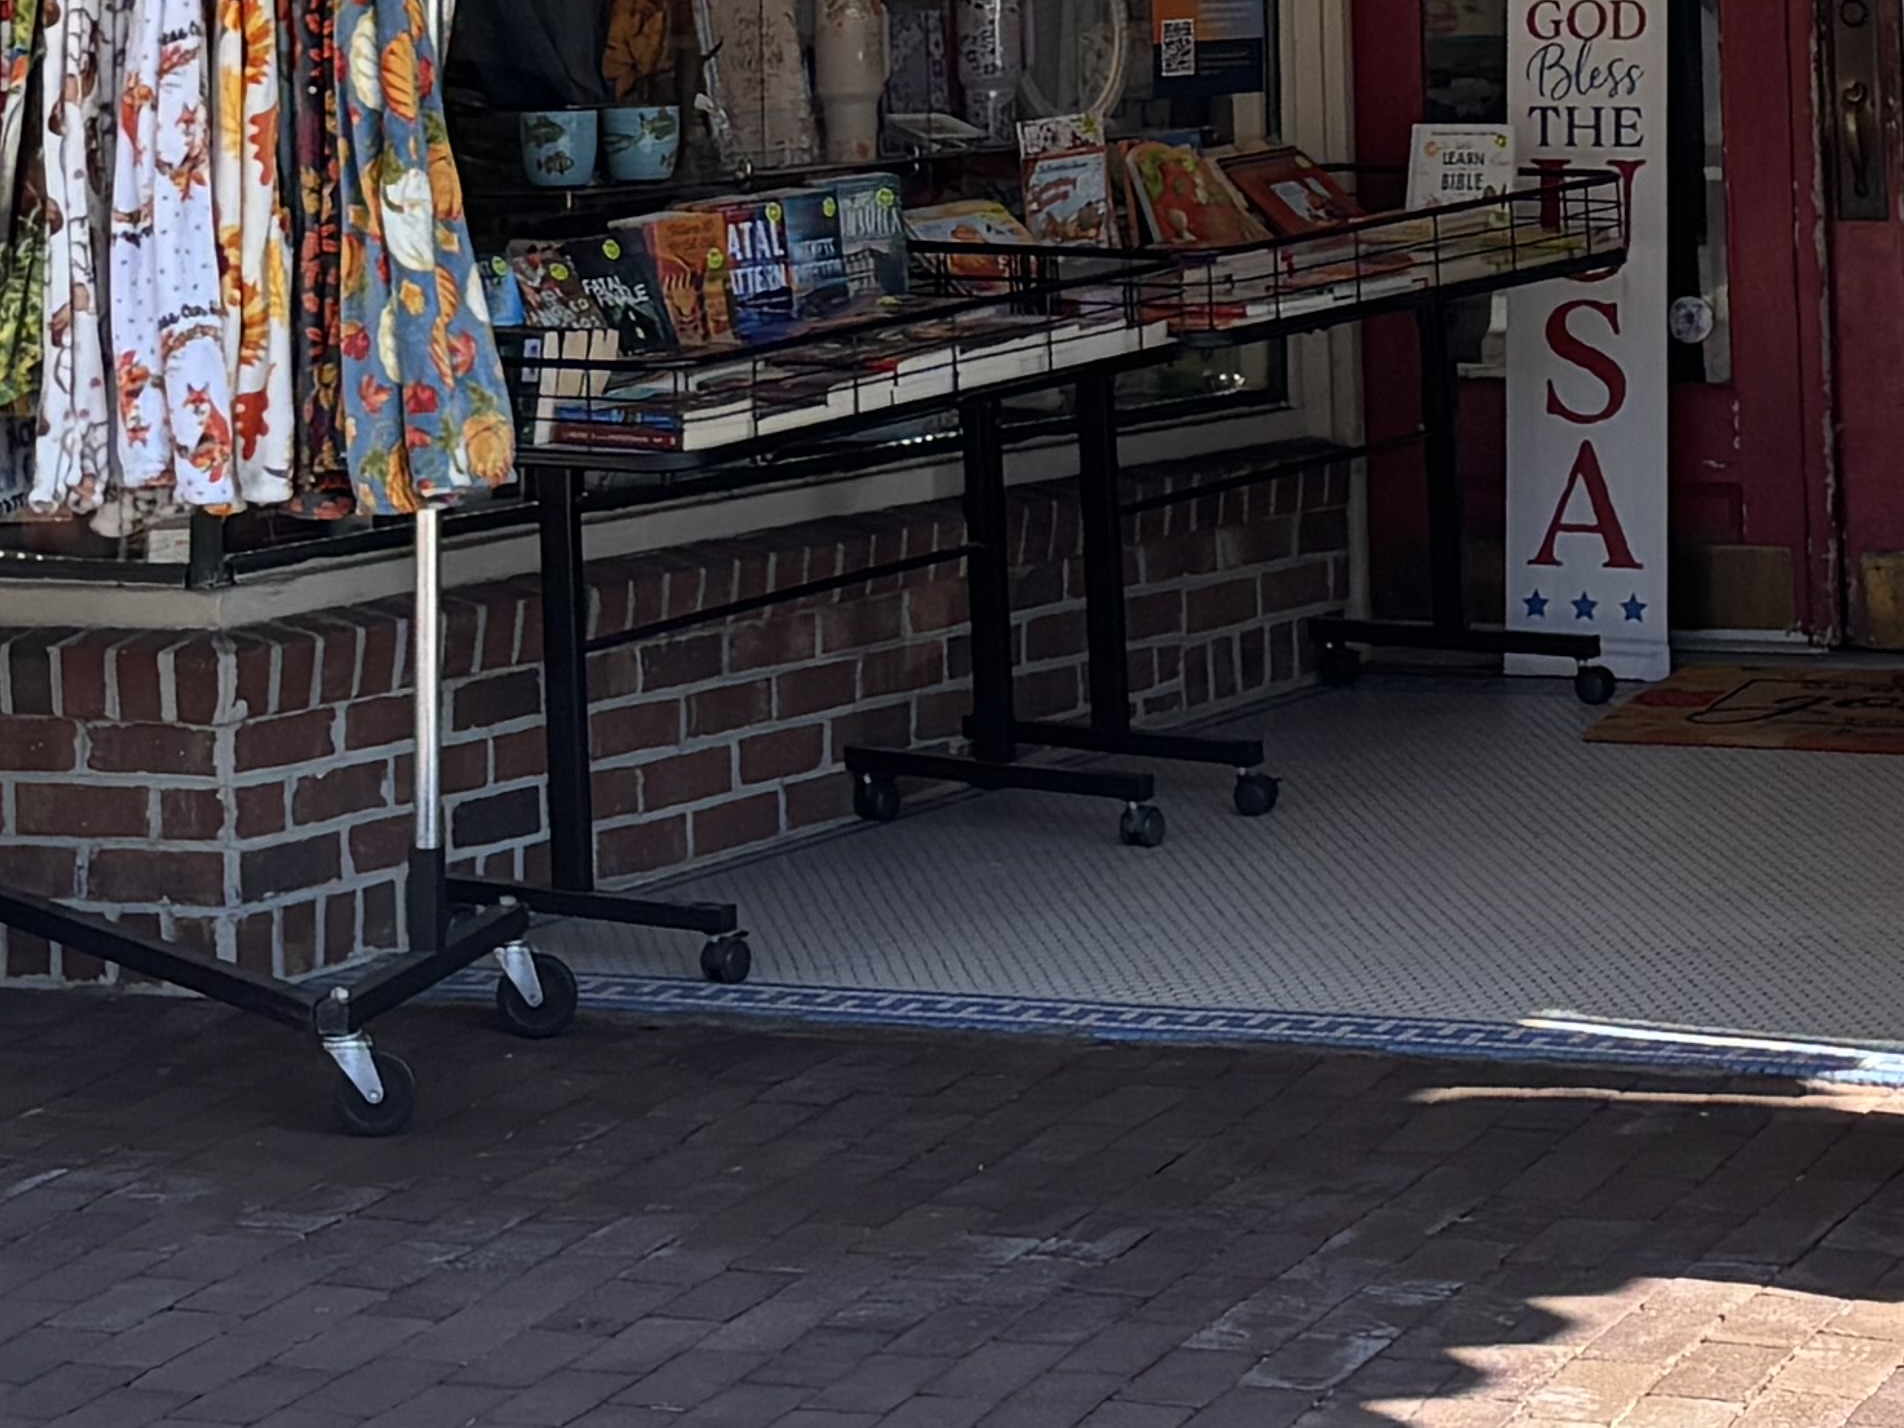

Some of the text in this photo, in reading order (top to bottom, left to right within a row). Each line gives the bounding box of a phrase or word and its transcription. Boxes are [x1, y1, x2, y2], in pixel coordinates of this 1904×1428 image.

[1526, 41, 1645, 102] Bless
[1528, 106, 1645, 148] THE
[1442, 151, 1485, 166] LEARN
[1441, 173, 1484, 191] BIBLE
[726, 220, 787, 261] ATAL
[581, 274, 623, 296] FATAL
[594, 283, 650, 309] FINALE
